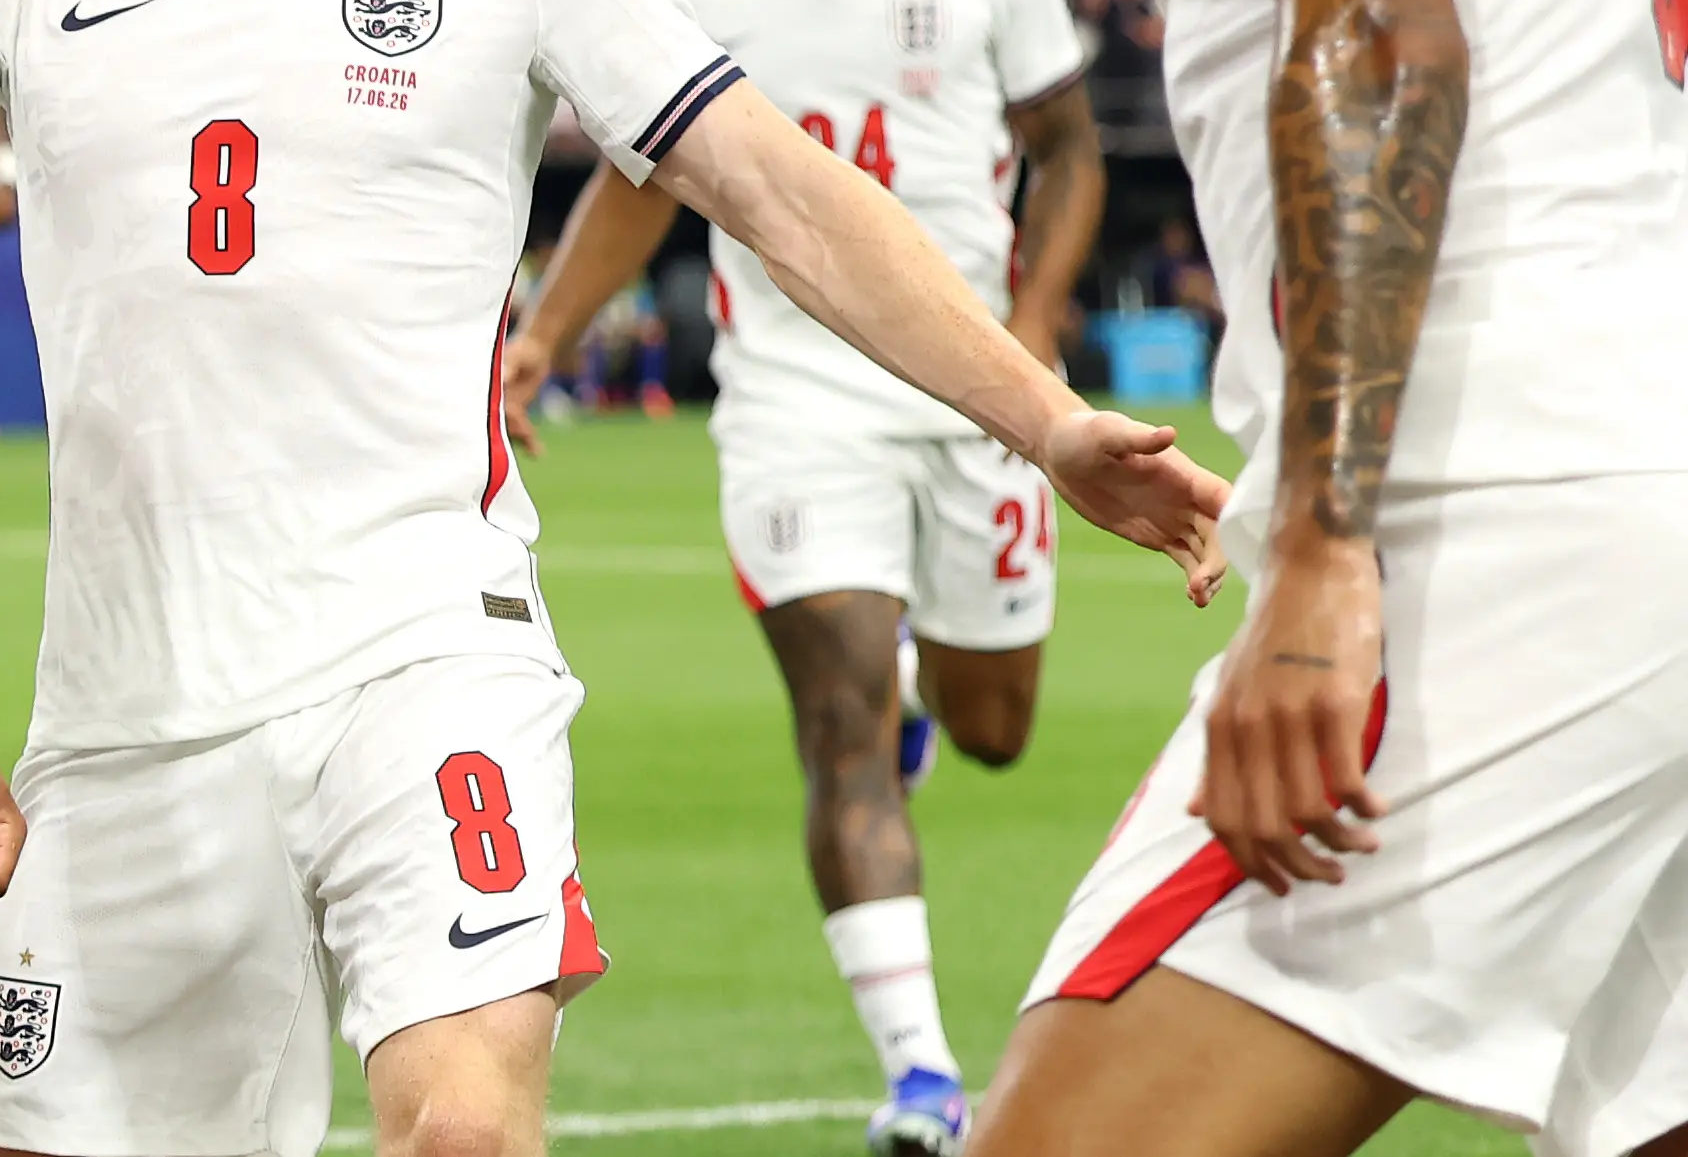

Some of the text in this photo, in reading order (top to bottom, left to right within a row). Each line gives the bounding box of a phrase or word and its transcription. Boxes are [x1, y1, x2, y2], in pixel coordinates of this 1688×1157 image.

[344, 64, 417, 89] CROATIA
[347, 87, 408, 111] 17.06.26
[187, 119, 259, 276] 8
[434, 750, 528, 894] 8
